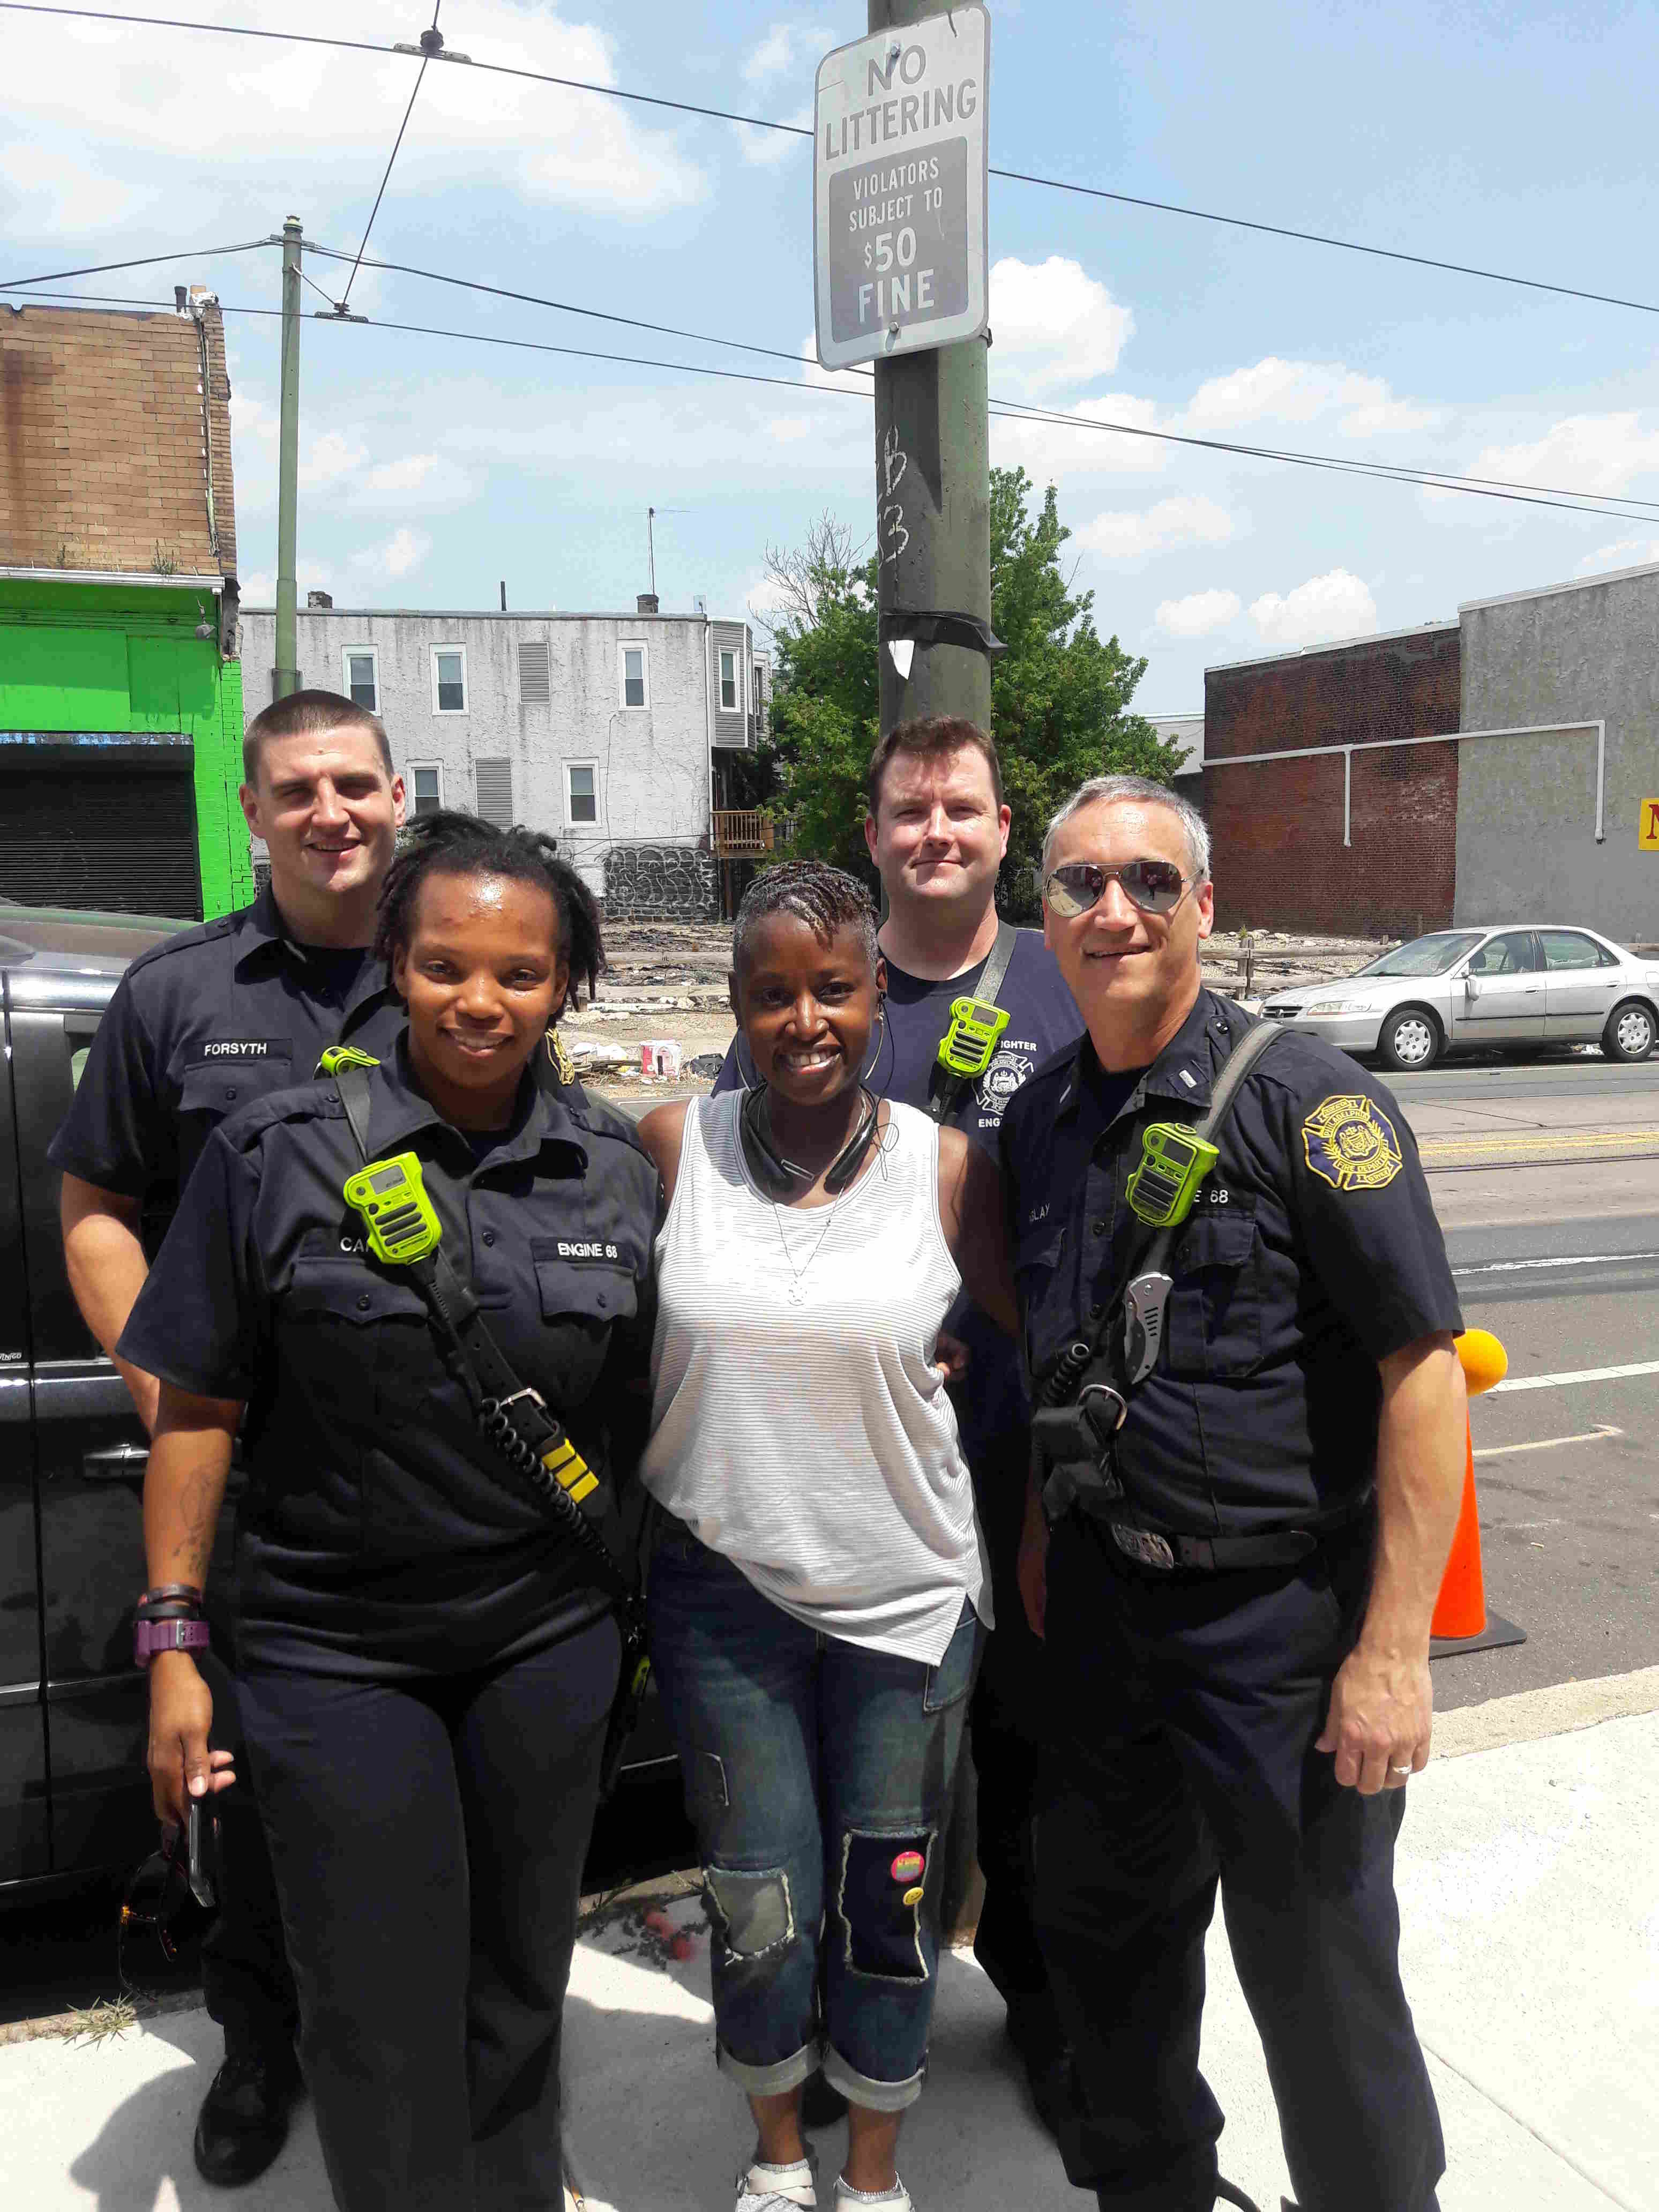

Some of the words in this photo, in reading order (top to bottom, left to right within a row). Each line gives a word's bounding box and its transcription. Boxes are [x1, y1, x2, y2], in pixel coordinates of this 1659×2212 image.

[868, 44, 927, 96] NO
[825, 78, 976, 160] LITTERING
[853, 156, 939, 200] VIOLATORS
[849, 195, 913, 232] SUBJECT
[924, 186, 943, 212] TO
[864, 227, 917, 273] $50
[859, 269, 935, 322] FINE
[204, 1043, 267, 1056] FORSYTH
[978, 1118, 1002, 1127] ENG
[1337, 1161, 1355, 1172] FIRE
[1210, 1189, 1229, 1204] 68
[557, 1243, 603, 1257] ENGINE
[606, 1245, 617, 1259] 68
